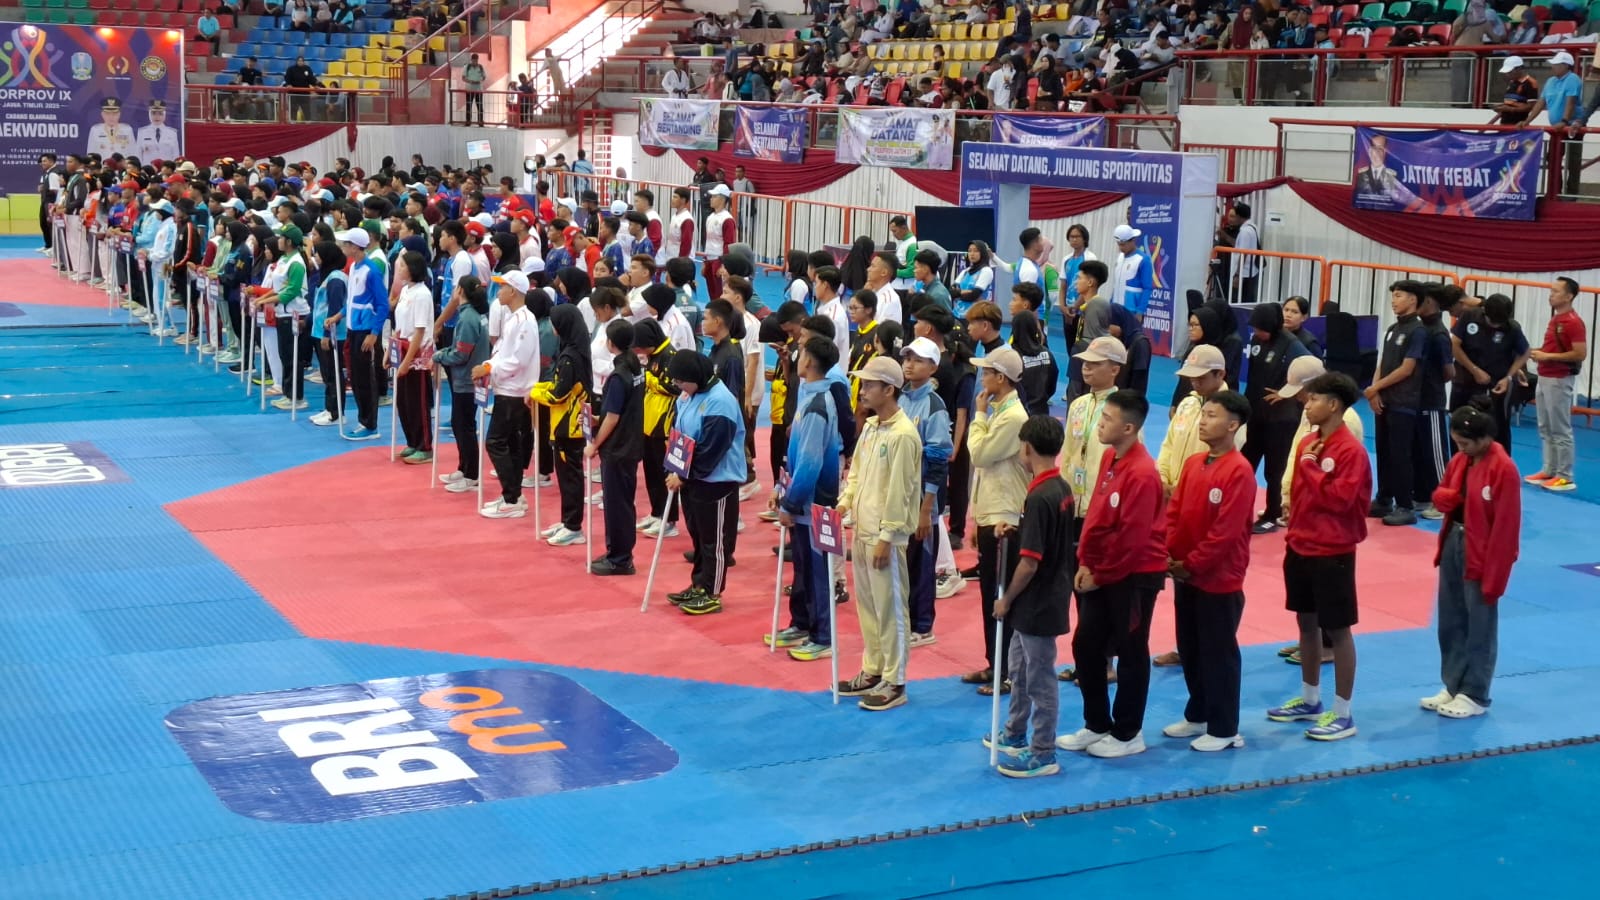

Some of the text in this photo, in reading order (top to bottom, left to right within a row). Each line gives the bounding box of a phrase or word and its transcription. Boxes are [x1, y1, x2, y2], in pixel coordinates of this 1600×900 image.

[0, 89, 72, 101] ORPROV IX
[662, 111, 696, 122] SELAMAT
[656, 123, 702, 136] BERTANDING
[753, 121, 780, 137] SELAMAT
[870, 130, 916, 141] DATANG
[968, 152, 1173, 184] SELAMAT DATANG, JUNJUNG SPORTIVITAS
[1402, 165, 1491, 187] JATIM HEBAT
[1143, 317, 1170, 332] WONDO
[258, 697, 479, 796] BRI
